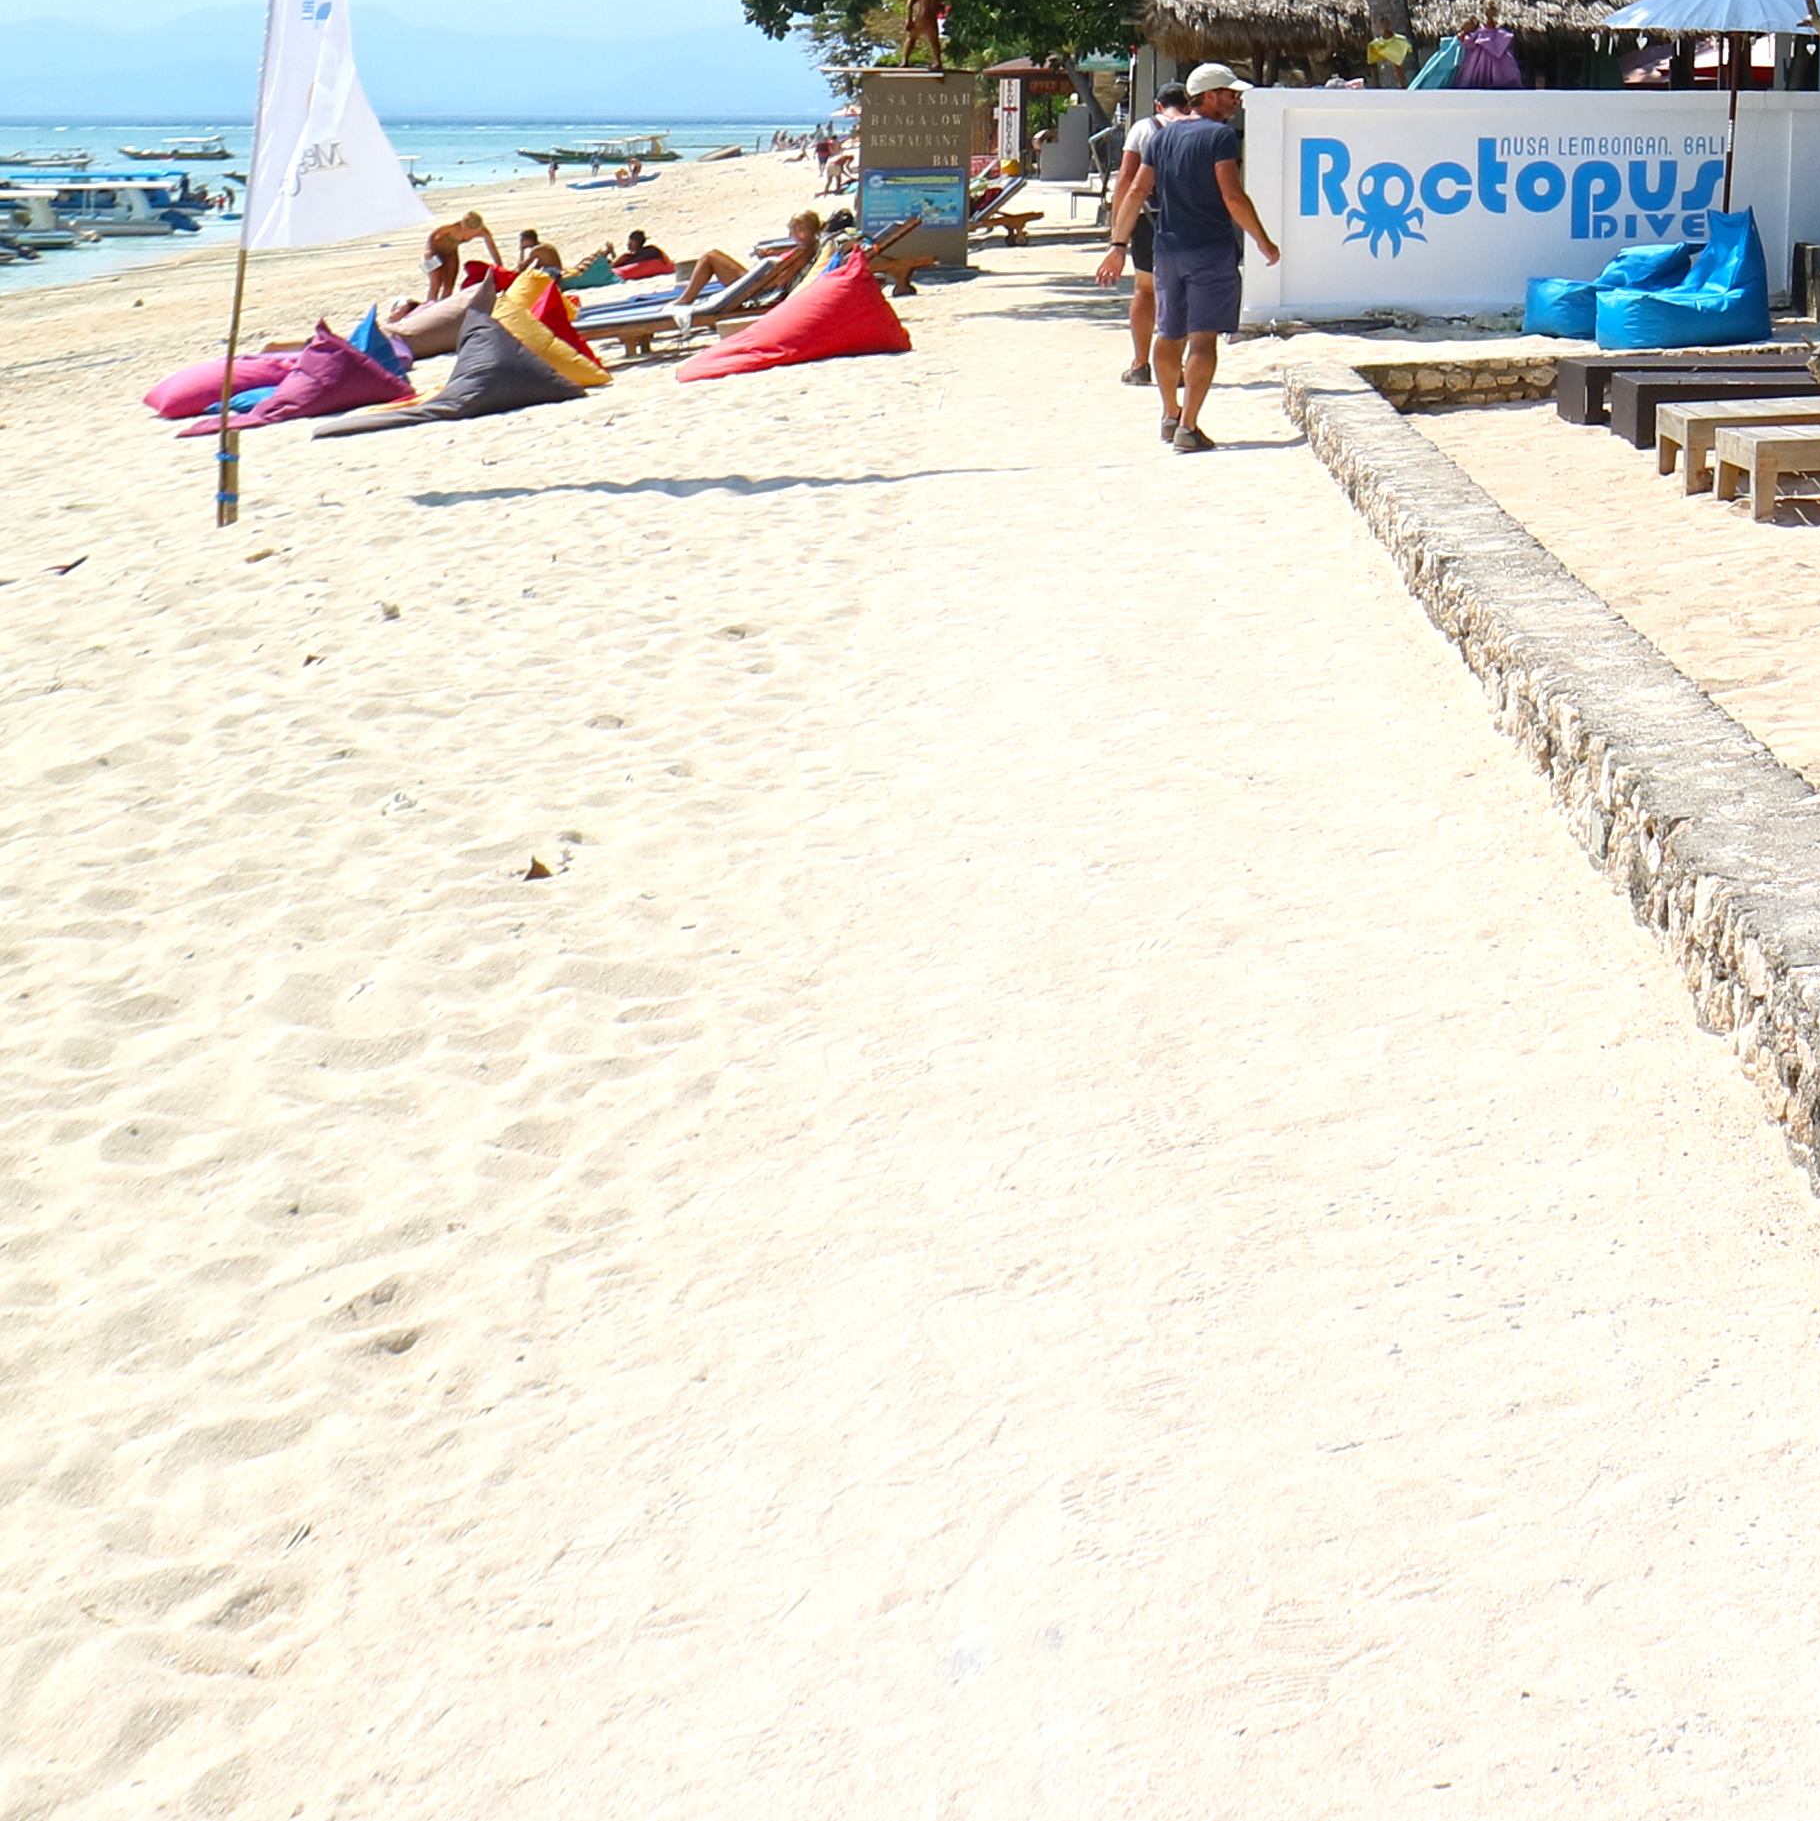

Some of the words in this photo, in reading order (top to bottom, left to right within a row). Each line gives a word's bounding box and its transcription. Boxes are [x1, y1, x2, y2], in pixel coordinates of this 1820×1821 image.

[917, 92, 971, 106] INDAH
[871, 113, 963, 126] BUNGALOW
[870, 134, 960, 148] RESTAURANT
[1500, 136, 1549, 156] NUSA
[1684, 136, 1724, 155] BALI
[932, 154, 959, 167] BAR
[1300, 137, 1724, 250] Roctopus
[1592, 213, 1706, 239] DIVE
